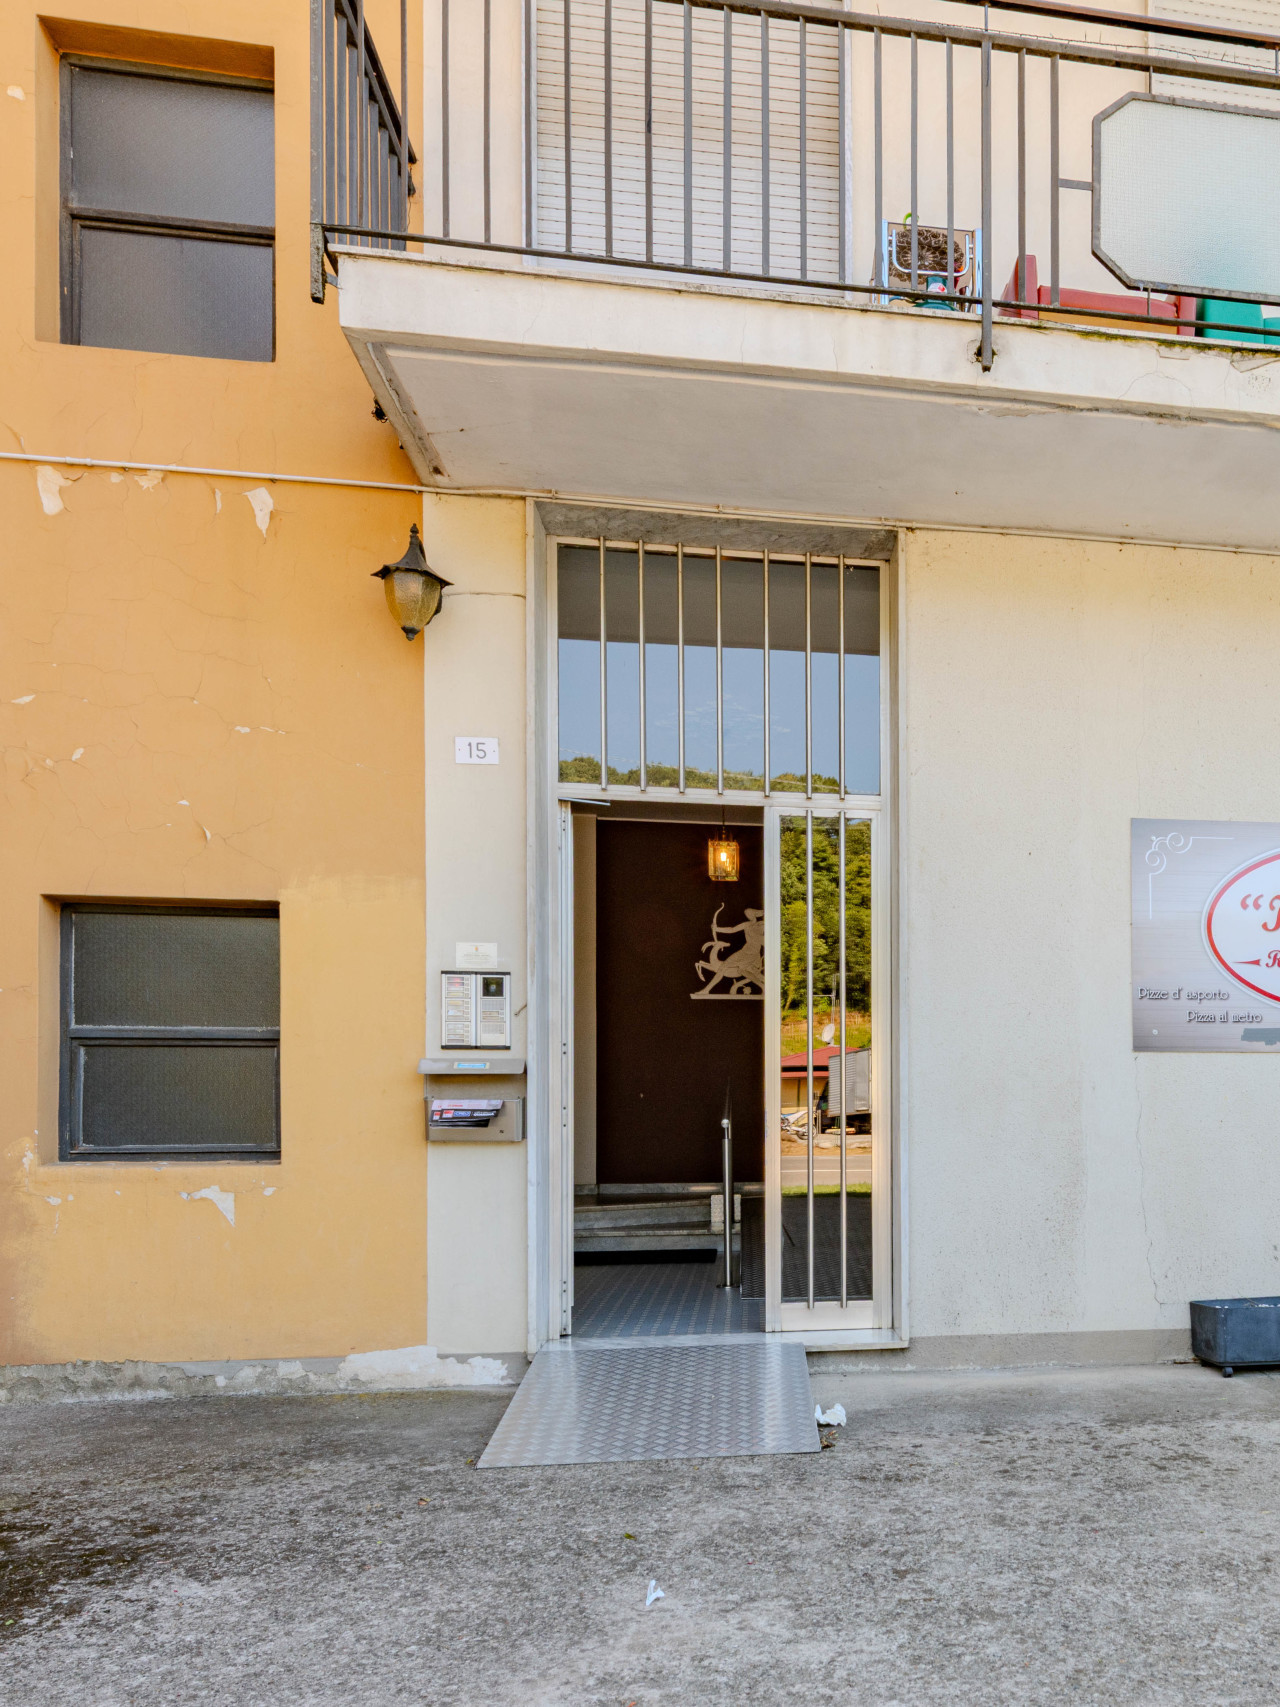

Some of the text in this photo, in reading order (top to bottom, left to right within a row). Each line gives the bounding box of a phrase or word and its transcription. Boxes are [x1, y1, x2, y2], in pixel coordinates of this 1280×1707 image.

[468, 741, 487, 759] 15
[1137, 987, 1169, 999] Pizze
[1186, 989, 1229, 1003] asporto
[1186, 1011, 1216, 1022] Pizza
[1219, 1011, 1228, 1022] al
